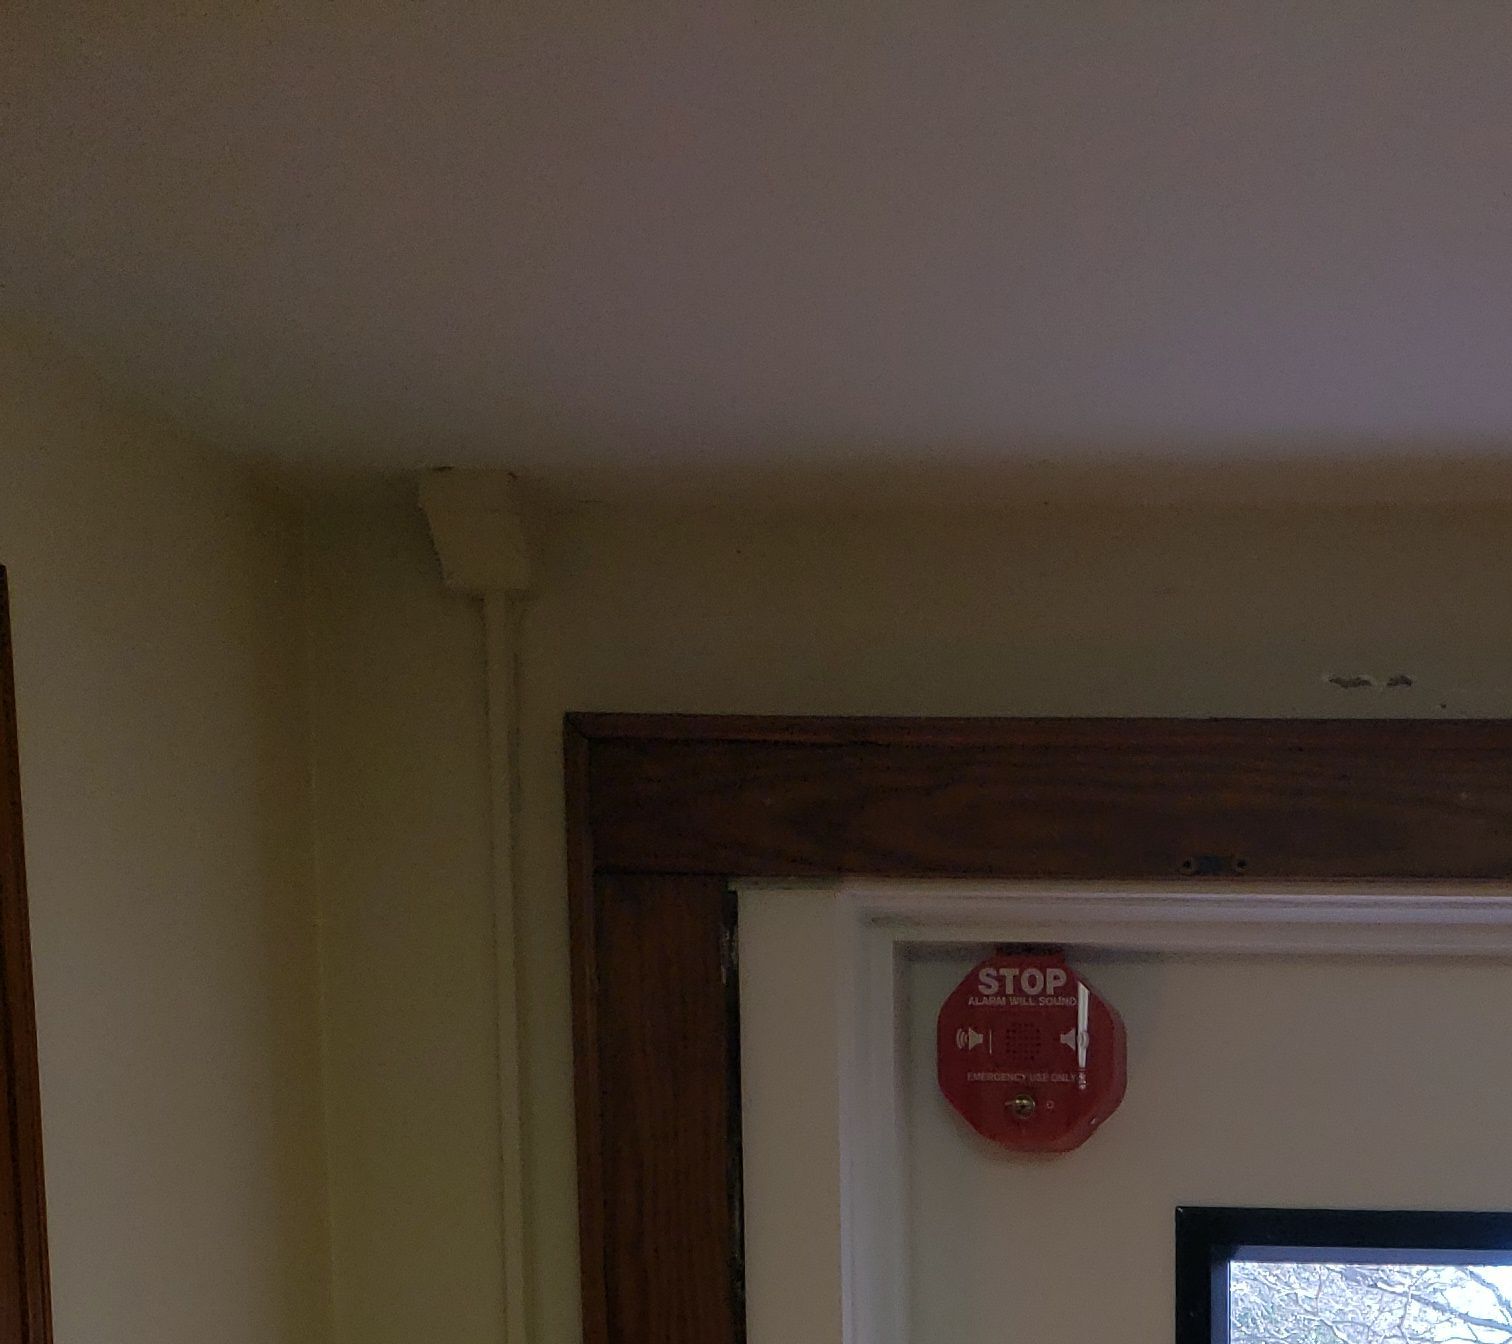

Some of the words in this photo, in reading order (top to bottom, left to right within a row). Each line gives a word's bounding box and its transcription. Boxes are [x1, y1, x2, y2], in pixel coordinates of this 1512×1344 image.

[978, 968, 1067, 995] STOP
[968, 996, 1006, 1006] ALARM
[1009, 996, 1035, 1006] WILL
[1039, 996, 1077, 1006] SOUND
[967, 1072, 1025, 1082] EMERGENCY
[1029, 1072, 1047, 1082] USE
[1051, 1072, 1075, 1082] ONLY
